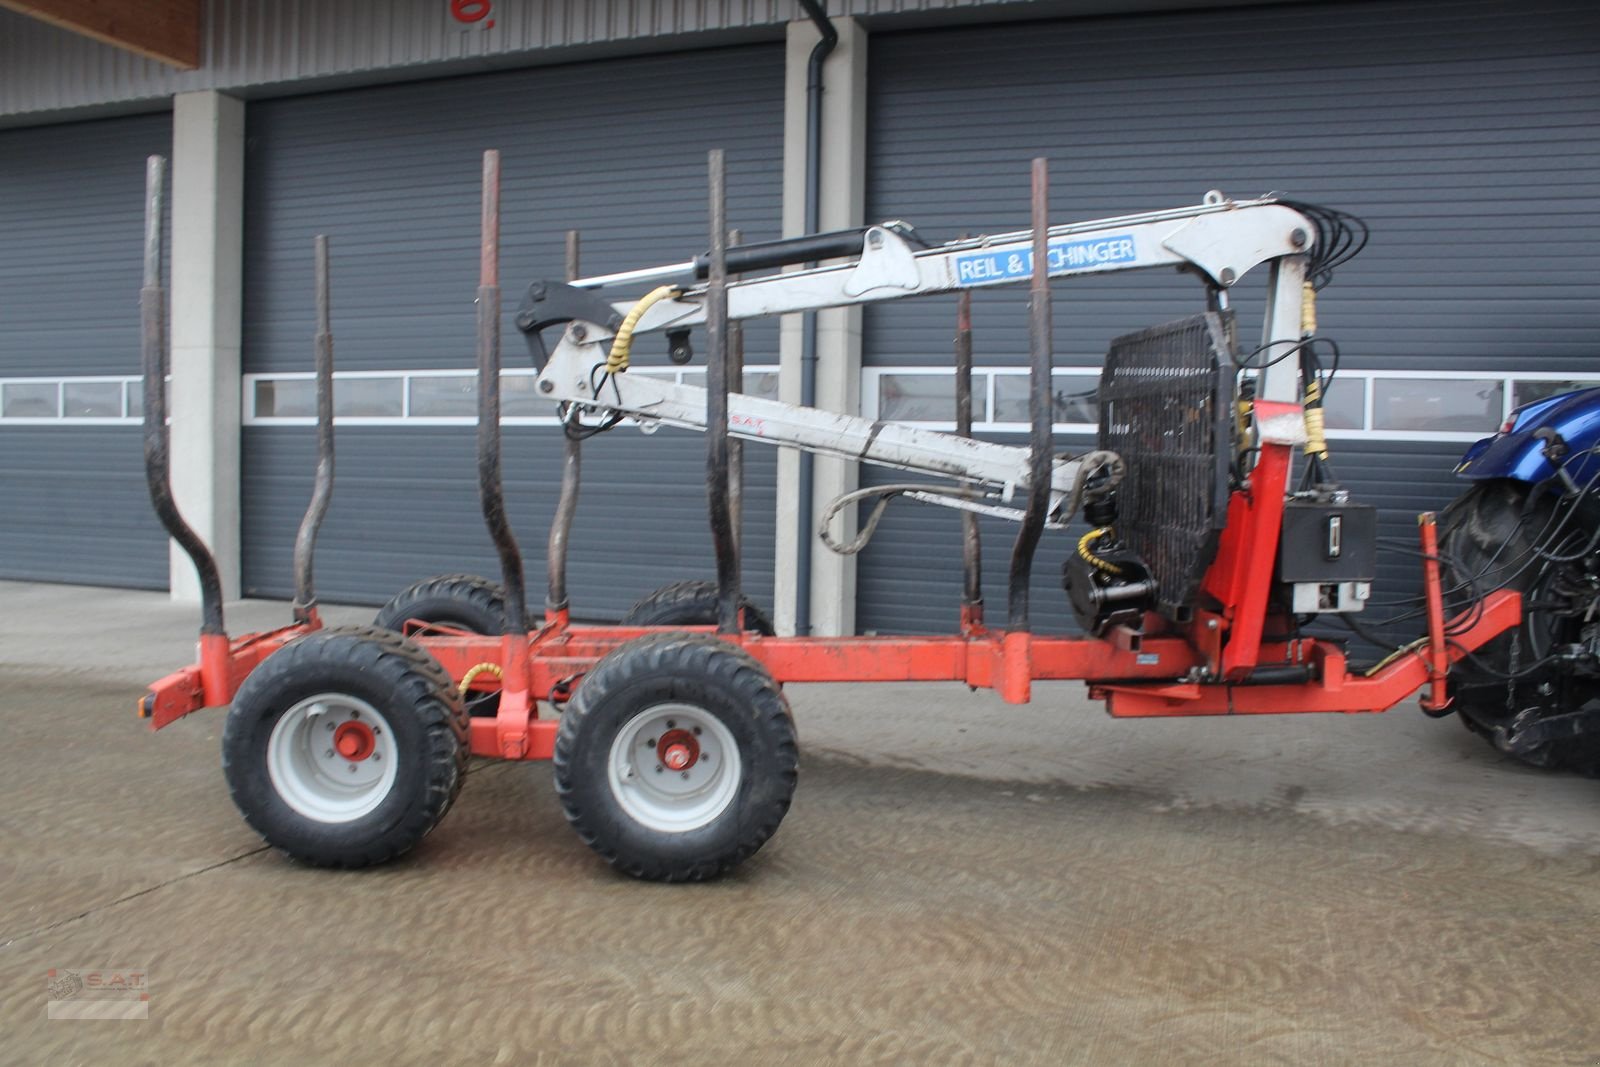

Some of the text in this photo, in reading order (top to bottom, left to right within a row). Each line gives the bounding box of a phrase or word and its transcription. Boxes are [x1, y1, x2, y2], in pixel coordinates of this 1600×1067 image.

[959, 239, 1135, 281] REIL & CHINGER
